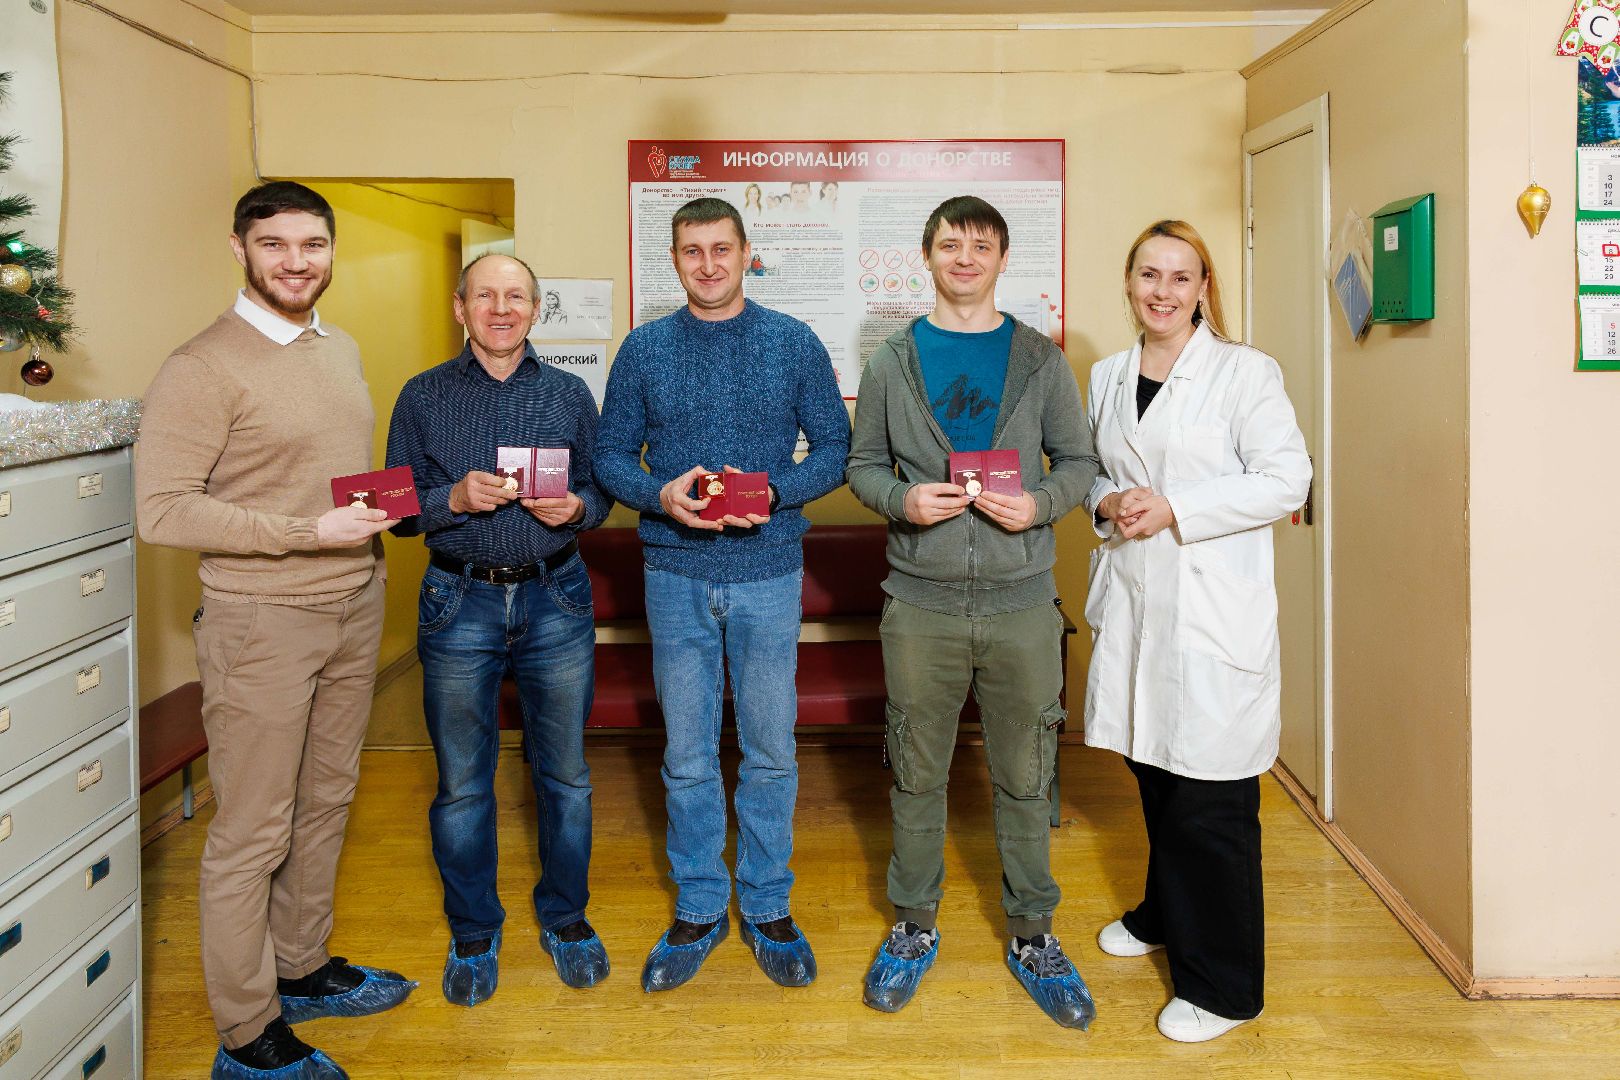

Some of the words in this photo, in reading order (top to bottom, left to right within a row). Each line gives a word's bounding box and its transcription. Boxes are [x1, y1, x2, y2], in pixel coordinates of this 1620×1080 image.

[723, 151, 869, 169] ИНФОРМАЦИЯ
[876, 151, 890, 167] О
[899, 151, 1013, 169] ДОНОРСТВЕ
[538, 354, 598, 365] ОНОРСКИЙ
